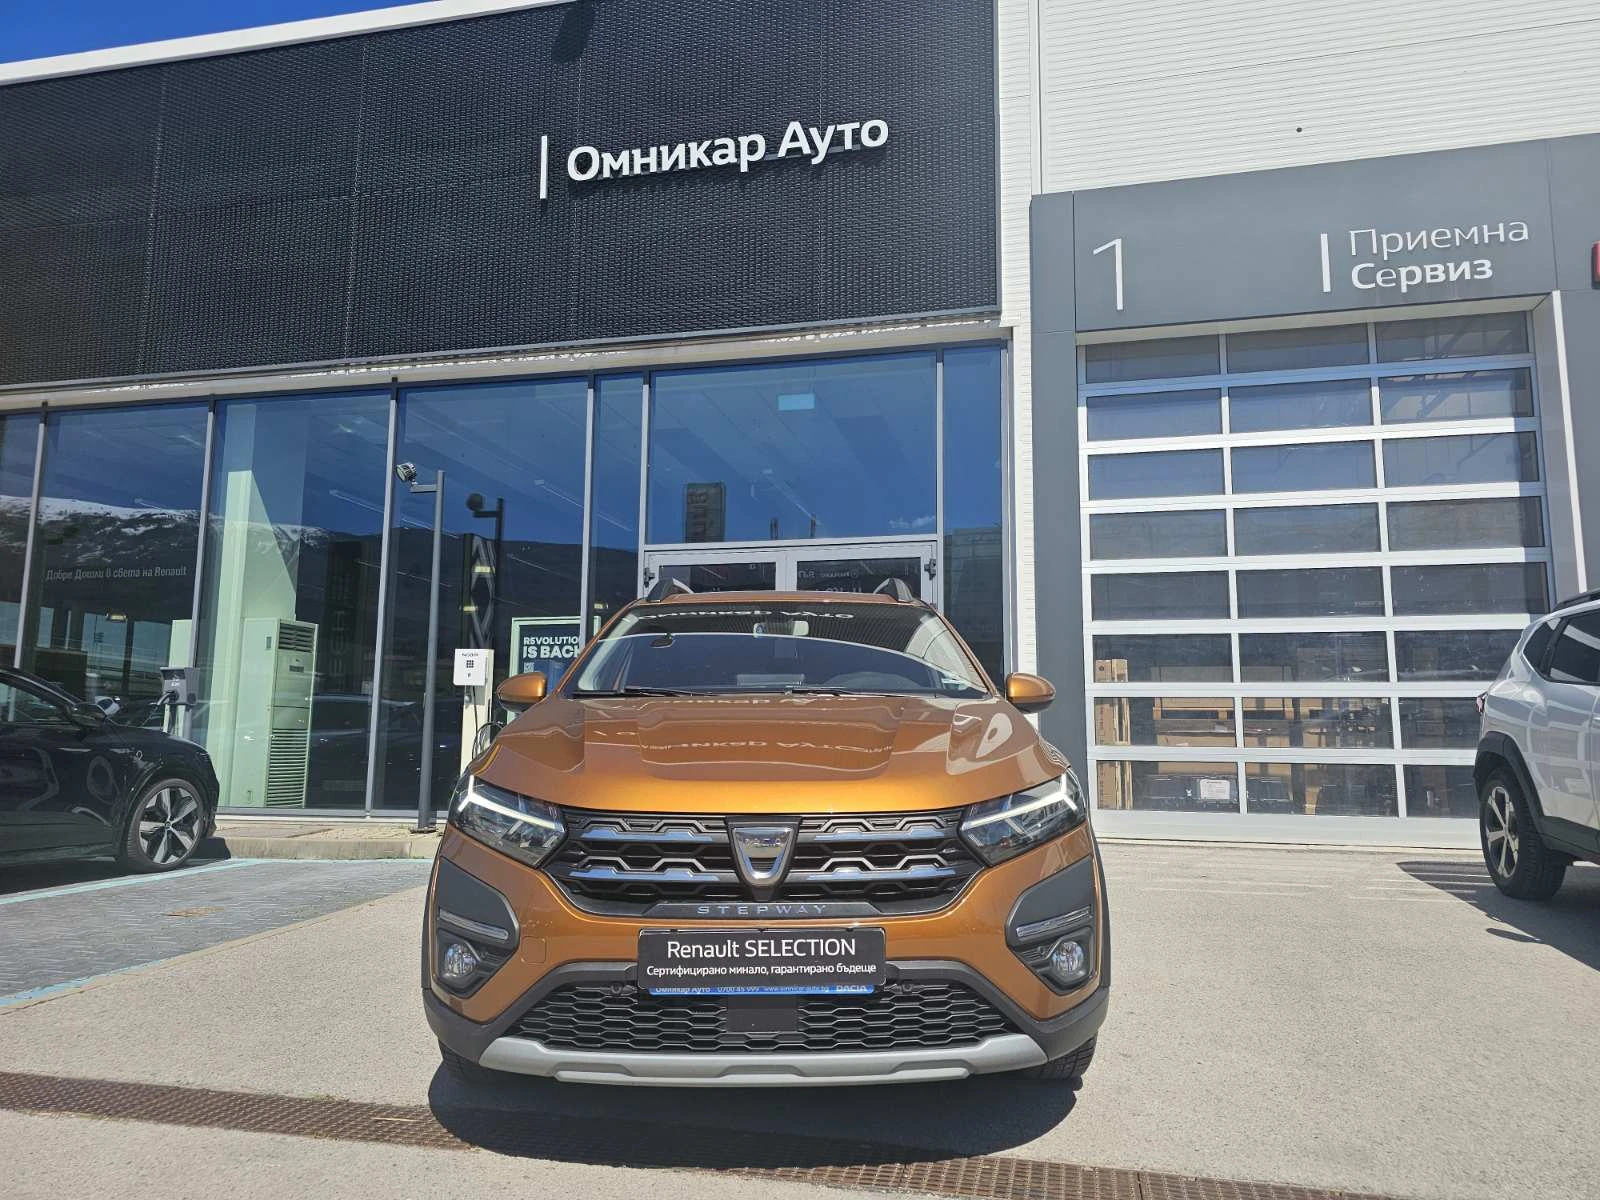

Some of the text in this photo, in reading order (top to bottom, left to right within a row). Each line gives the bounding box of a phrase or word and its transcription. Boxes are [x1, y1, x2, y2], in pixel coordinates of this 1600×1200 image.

[567, 119, 889, 181] Омникар Ауто
[1349, 218, 1530, 261] Приемна
[1092, 238, 1125, 311] 1
[1350, 256, 1494, 292] Сервиз
[522, 645, 538, 658] IS
[697, 904, 828, 915] STEPWAY
[667, 938, 856, 958] Renault SELECTION
[646, 962, 877, 978] Сертифицирано минало, гарантирано бъдеще
